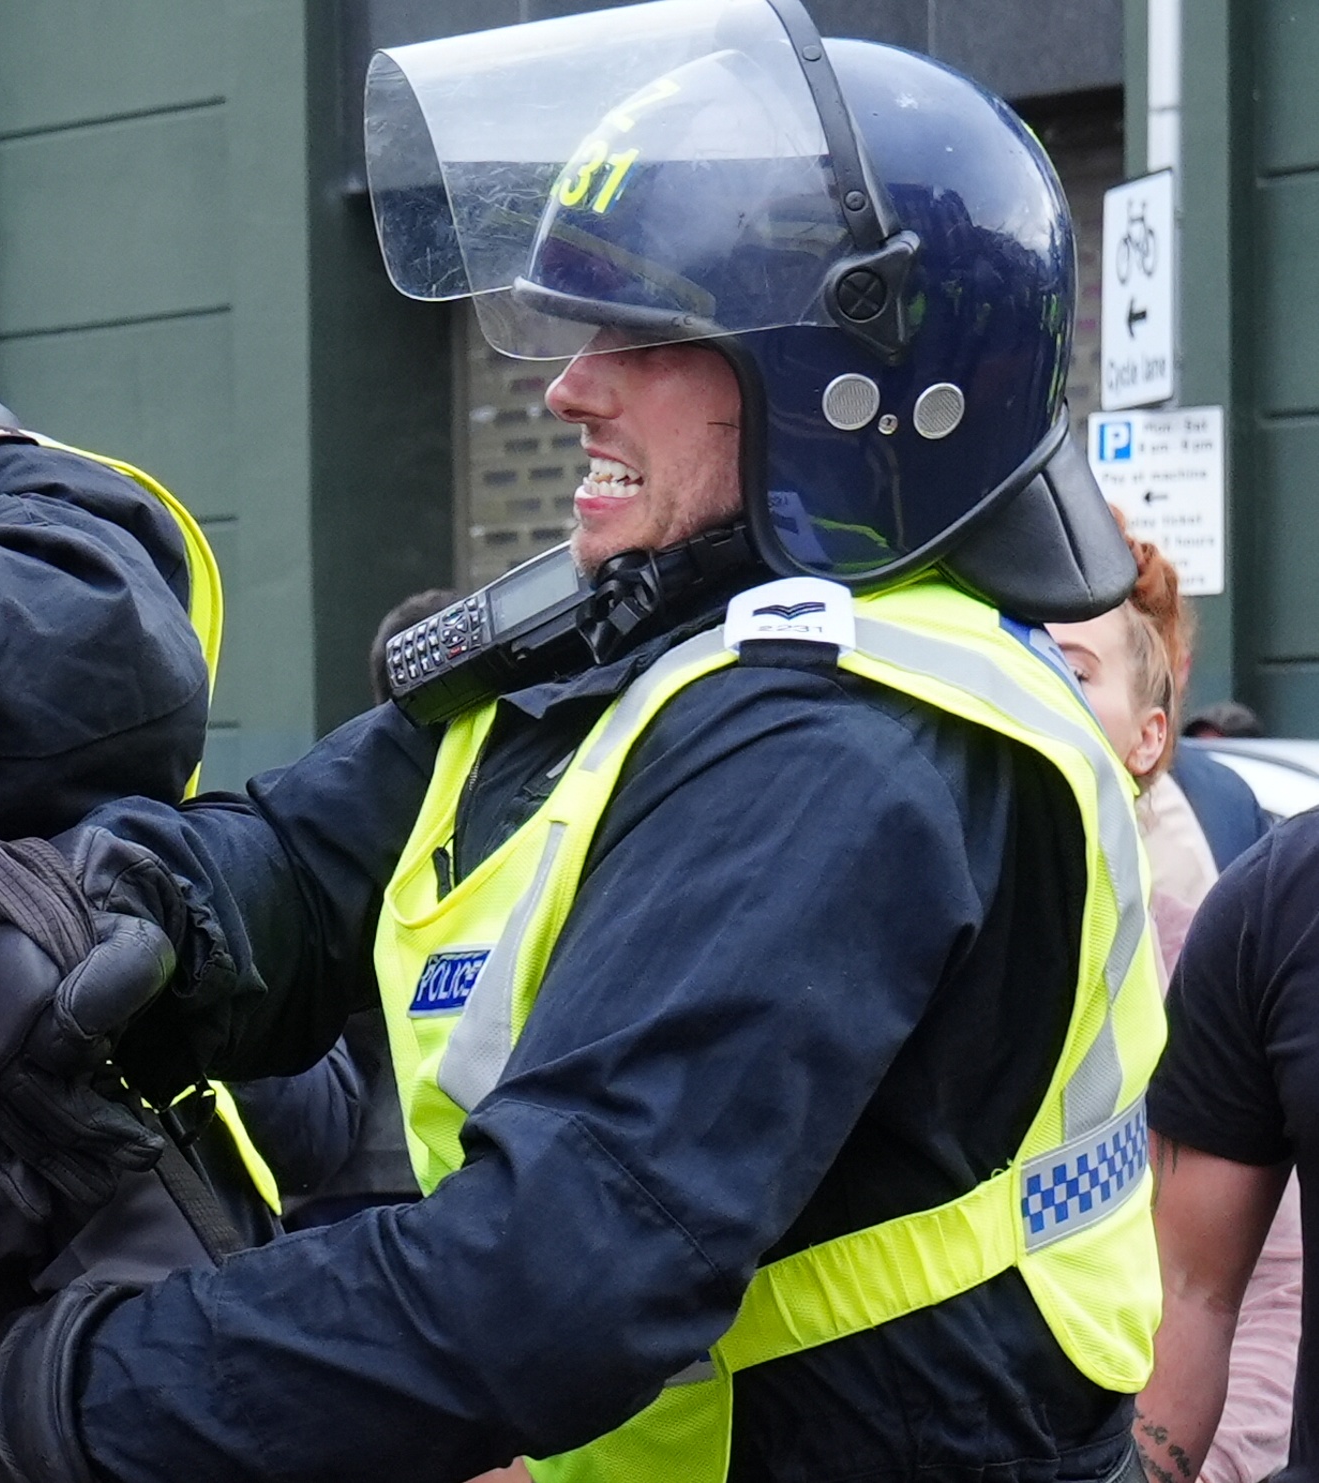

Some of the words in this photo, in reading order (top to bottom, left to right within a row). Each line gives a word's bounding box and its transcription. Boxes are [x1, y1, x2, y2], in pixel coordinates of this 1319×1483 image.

[550, 140, 640, 214] 31
[1106, 358, 1138, 395] Cycle
[1141, 354, 1166, 383] lane
[1102, 422, 1130, 460] P
[757, 624, 824, 634] 2231
[416, 959, 484, 1002] POLICE
